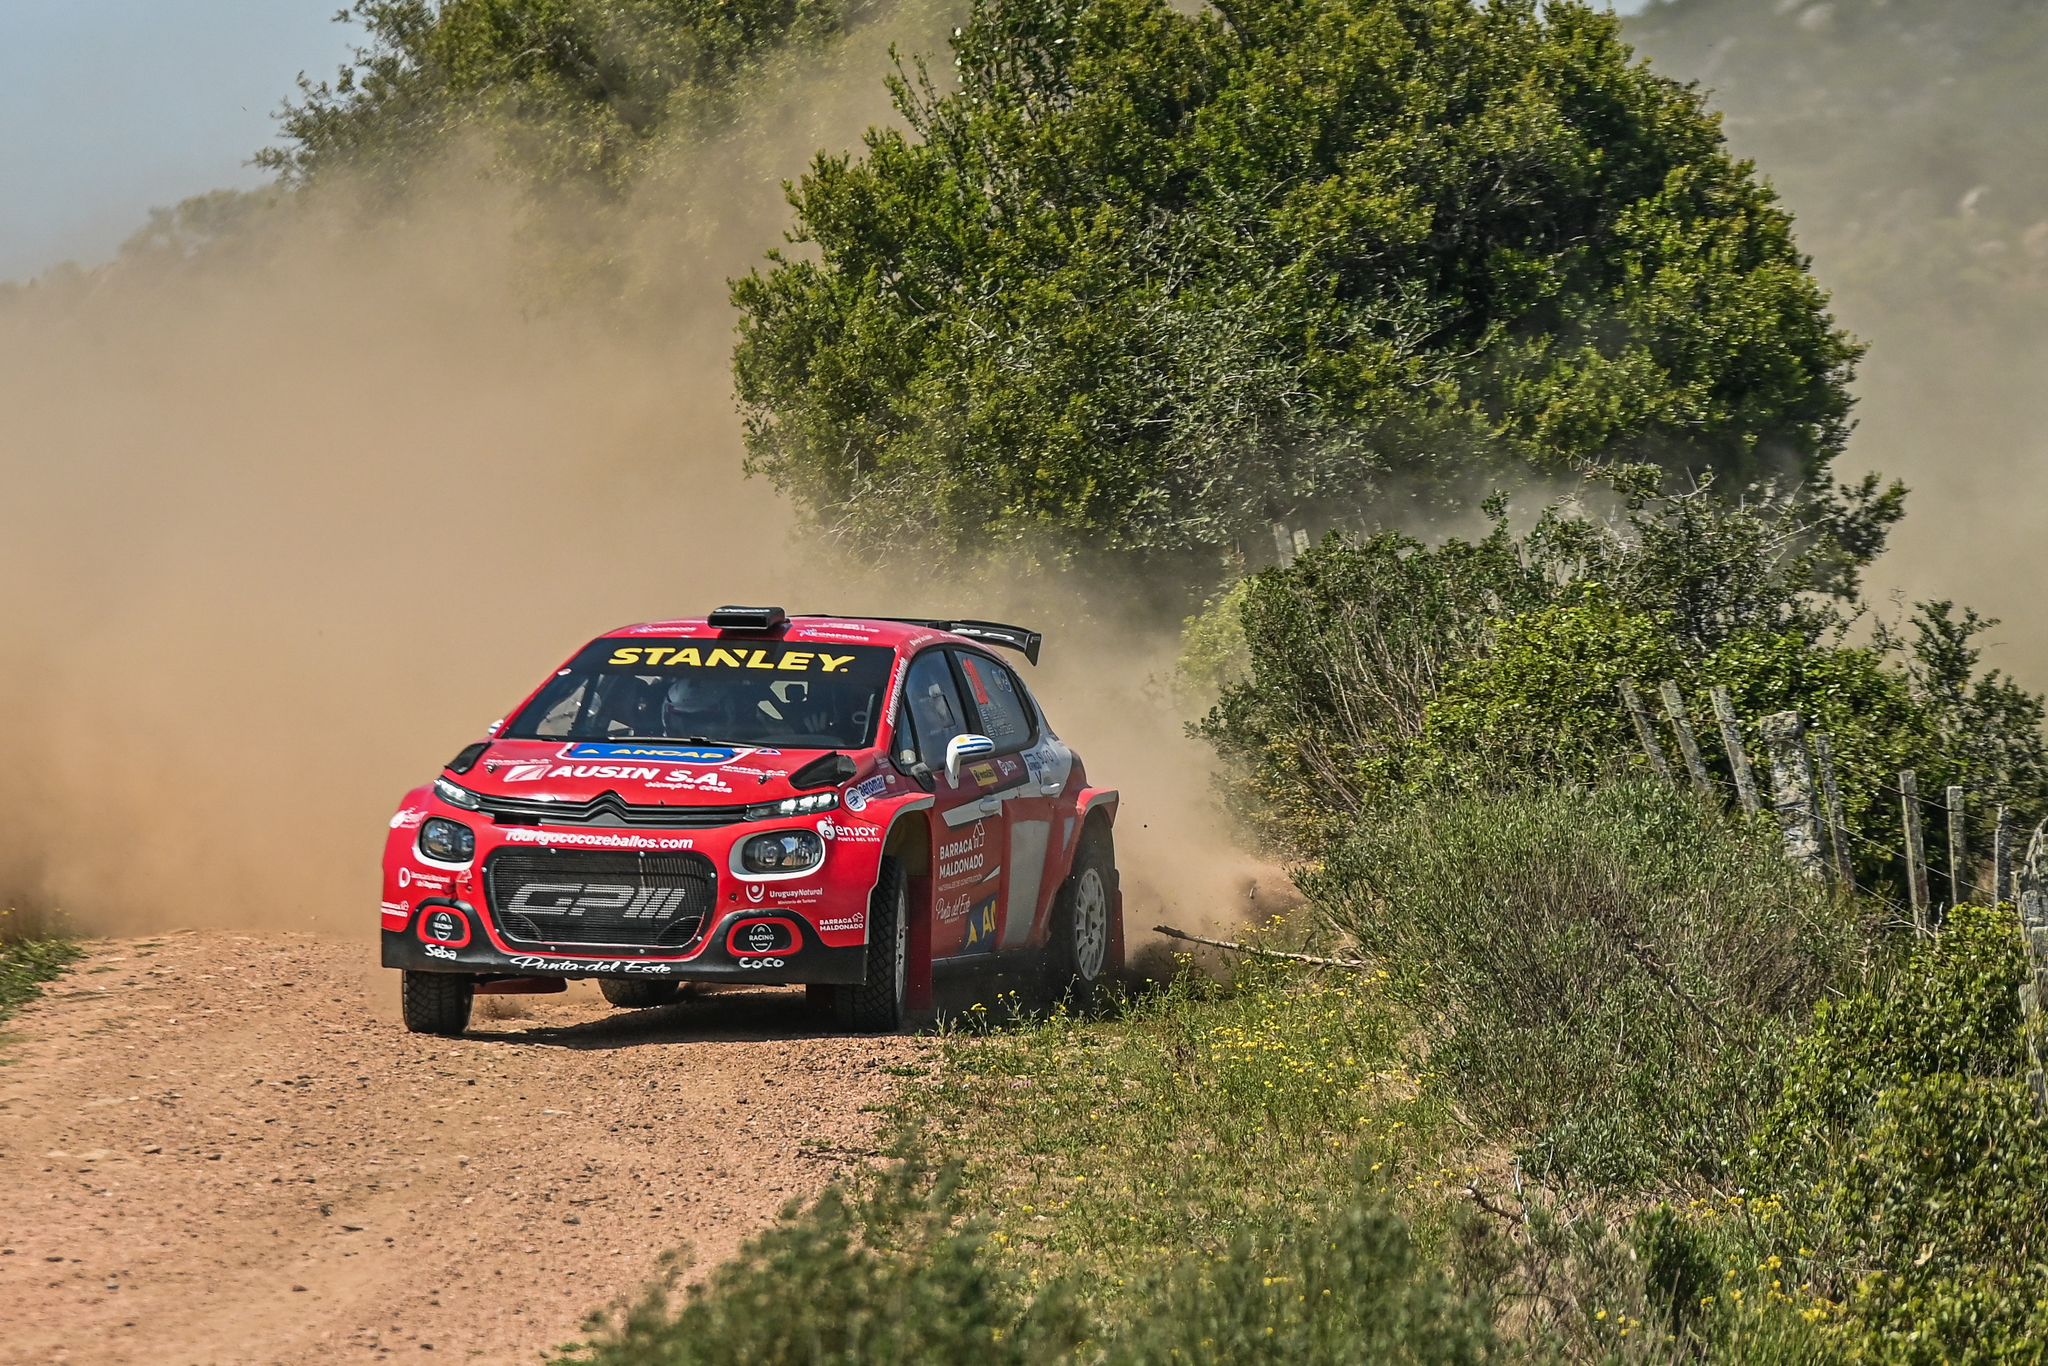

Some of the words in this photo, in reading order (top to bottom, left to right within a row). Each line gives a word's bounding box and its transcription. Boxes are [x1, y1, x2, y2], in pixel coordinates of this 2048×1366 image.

[610, 748, 726, 759] ANCAP
[548, 764, 657, 781] AUSIN
[664, 769, 727, 787] S.A.
[505, 827, 694, 849] rodrigococozeballos.com
[939, 837, 973, 861] BARRACA
[938, 853, 984, 880] MALDONADO
[819, 917, 852, 926] BARRACA
[819, 923, 864, 932] MALDONADO
[749, 933, 775, 942] RACING
[424, 943, 457, 961] Seba
